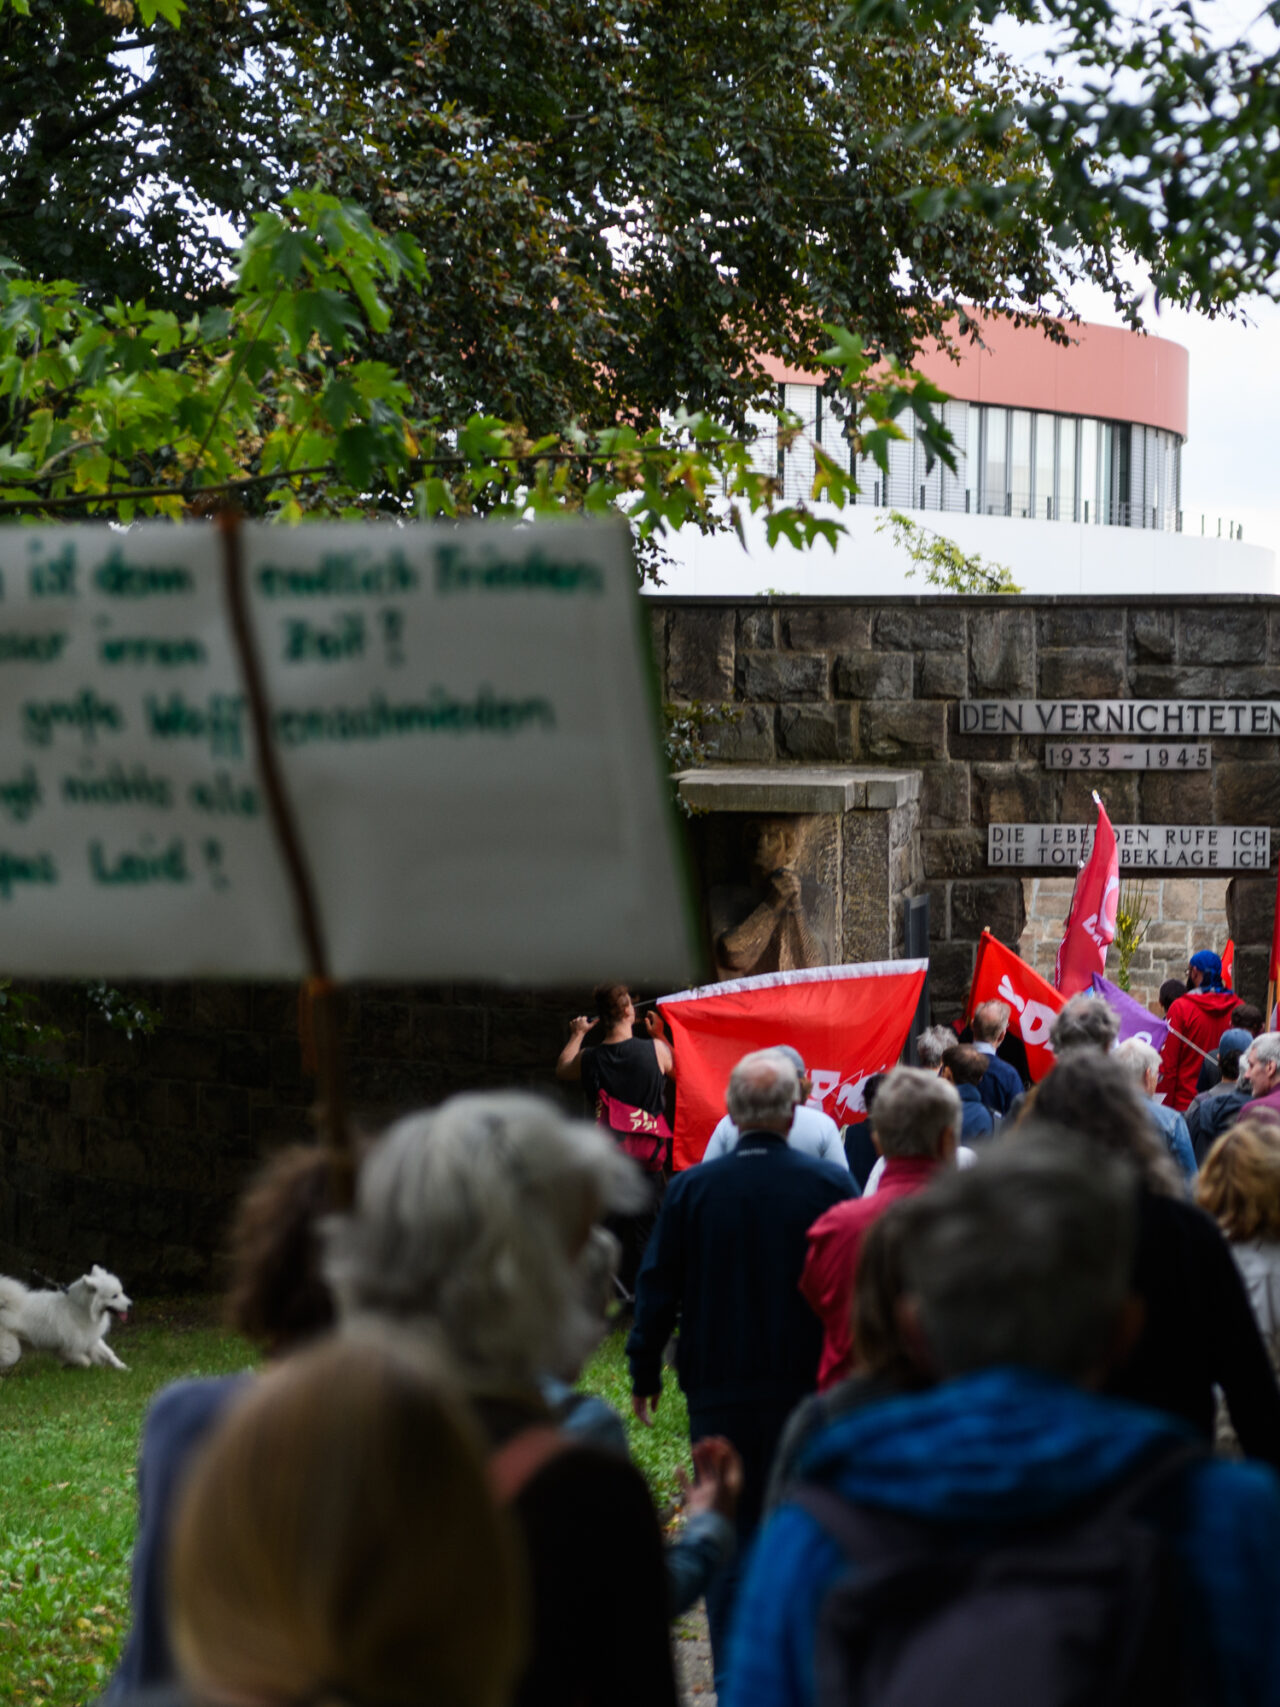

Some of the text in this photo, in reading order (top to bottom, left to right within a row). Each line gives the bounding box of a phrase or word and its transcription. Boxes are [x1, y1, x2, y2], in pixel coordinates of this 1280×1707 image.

[962, 704, 1023, 732] DEN
[993, 828, 1025, 843] DIE
[1166, 829, 1218, 846] RUFE
[1233, 830, 1266, 846] ICH
[992, 847, 1025, 863] DIE
[1122, 849, 1218, 866] BEKLAGE
[1233, 850, 1266, 866] ICH
